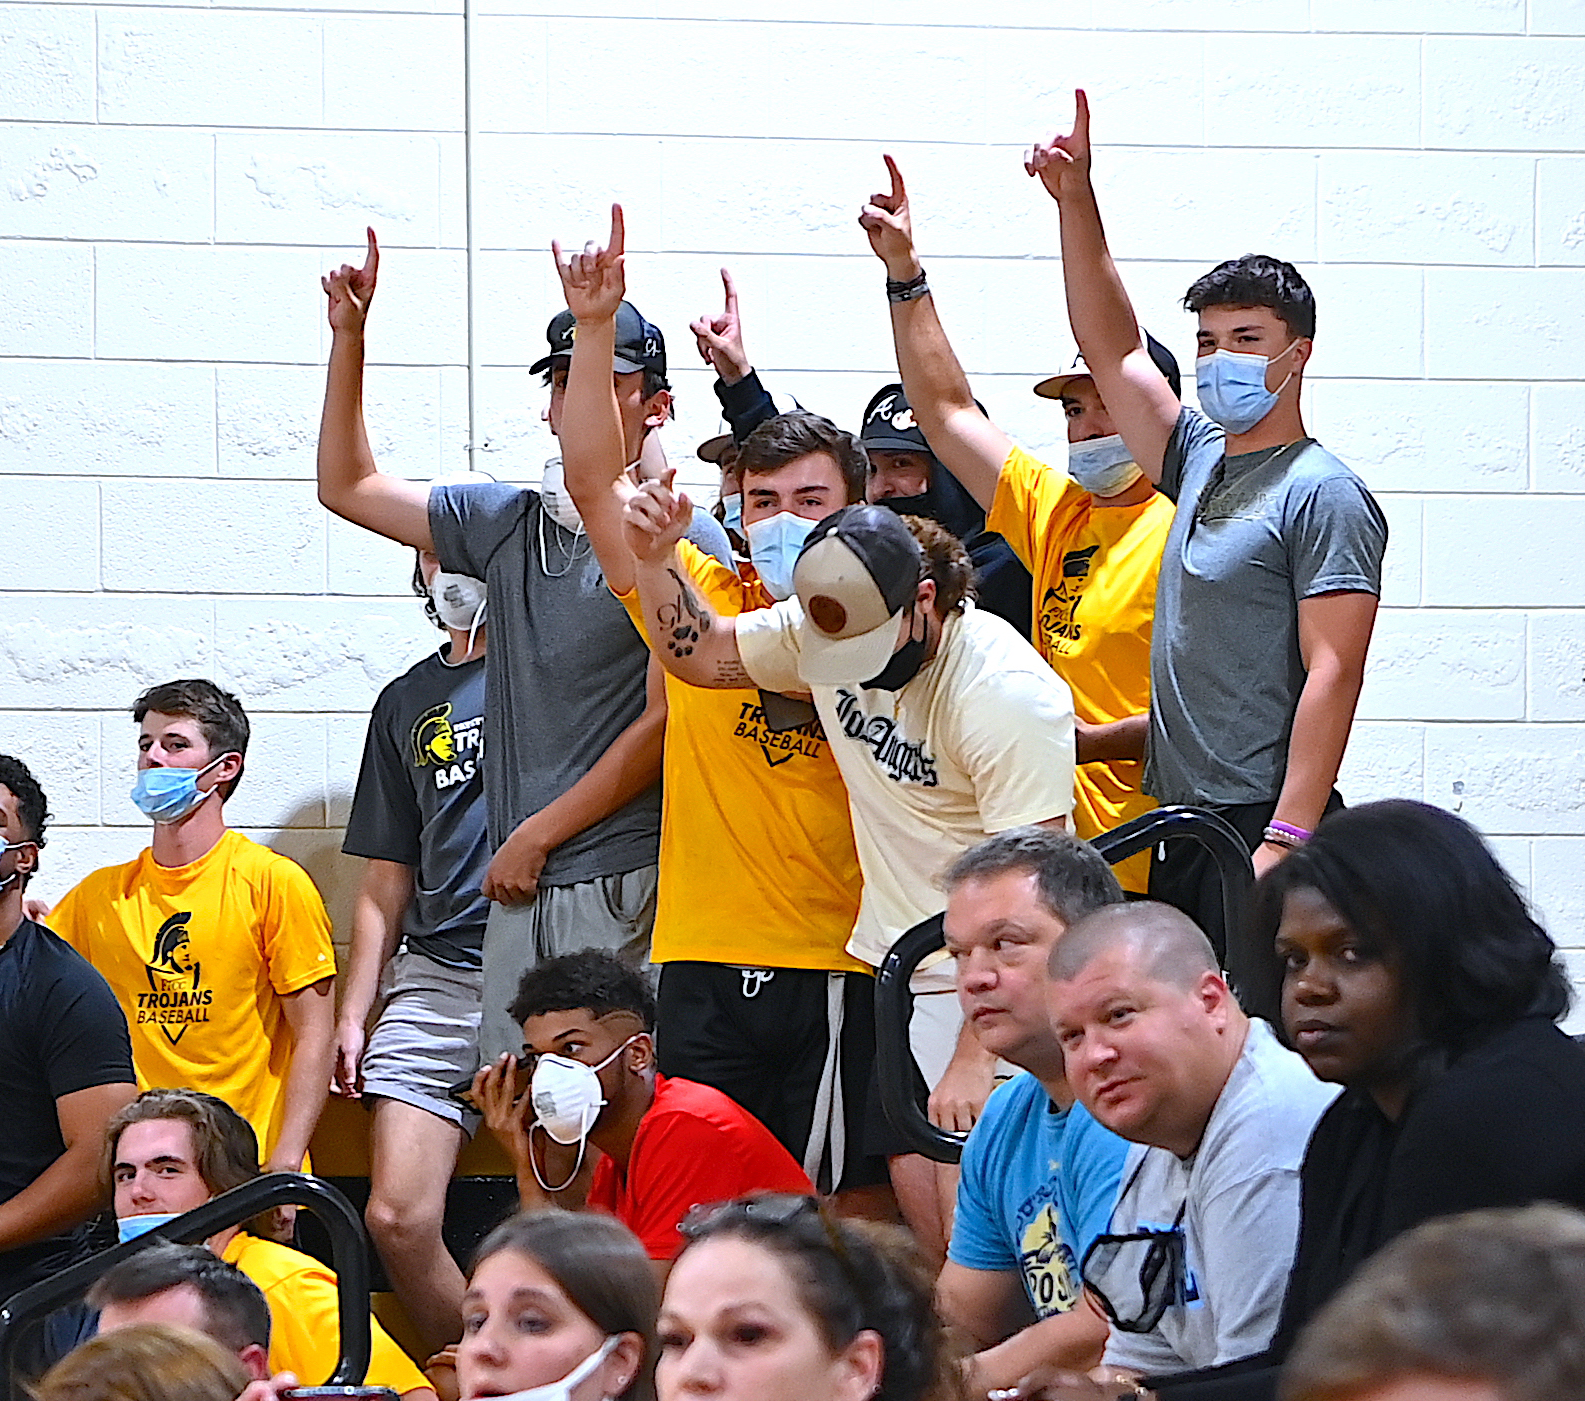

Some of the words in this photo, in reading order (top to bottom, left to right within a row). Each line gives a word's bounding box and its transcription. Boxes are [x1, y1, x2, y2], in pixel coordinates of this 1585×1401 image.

[734, 721, 821, 758] BASEBALL
[435, 760, 477, 789] BAS
[137, 989, 213, 1009] TROJANS
[137, 1008, 210, 1024] BASEBALL
